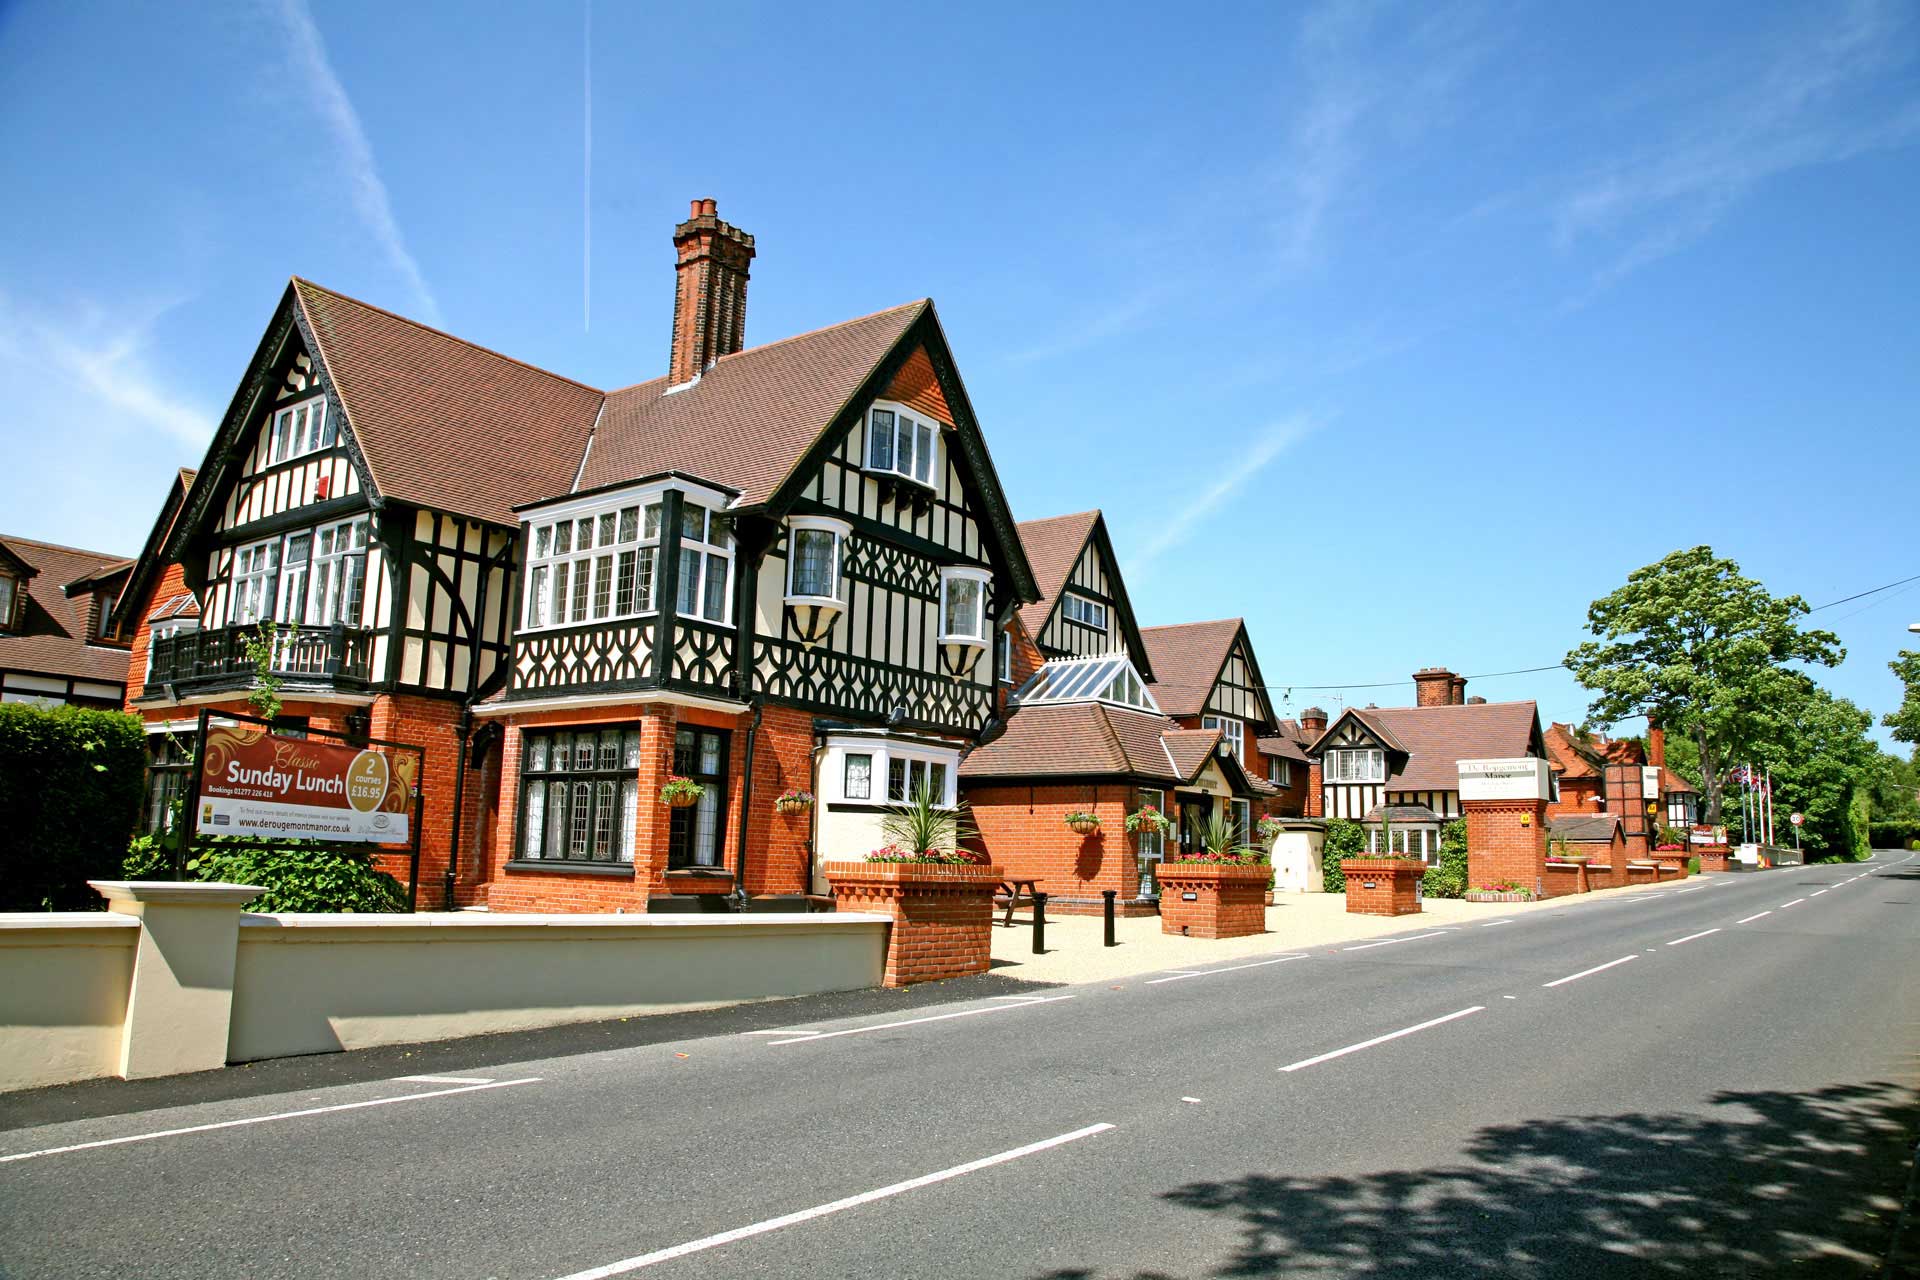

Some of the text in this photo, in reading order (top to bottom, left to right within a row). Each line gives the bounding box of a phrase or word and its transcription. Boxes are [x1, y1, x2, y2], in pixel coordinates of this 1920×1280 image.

[273, 741, 320, 770] Classic
[365, 758, 376, 776] 2
[227, 760, 344, 795] Sunday Lunch
[355, 775, 382, 785] courses
[208, 785, 233, 796] Bookings
[234, 788, 251, 796] 01277
[351, 785, 381, 799] £16.95
[239, 818, 351, 833] www.derougemontmanor.co.uk
